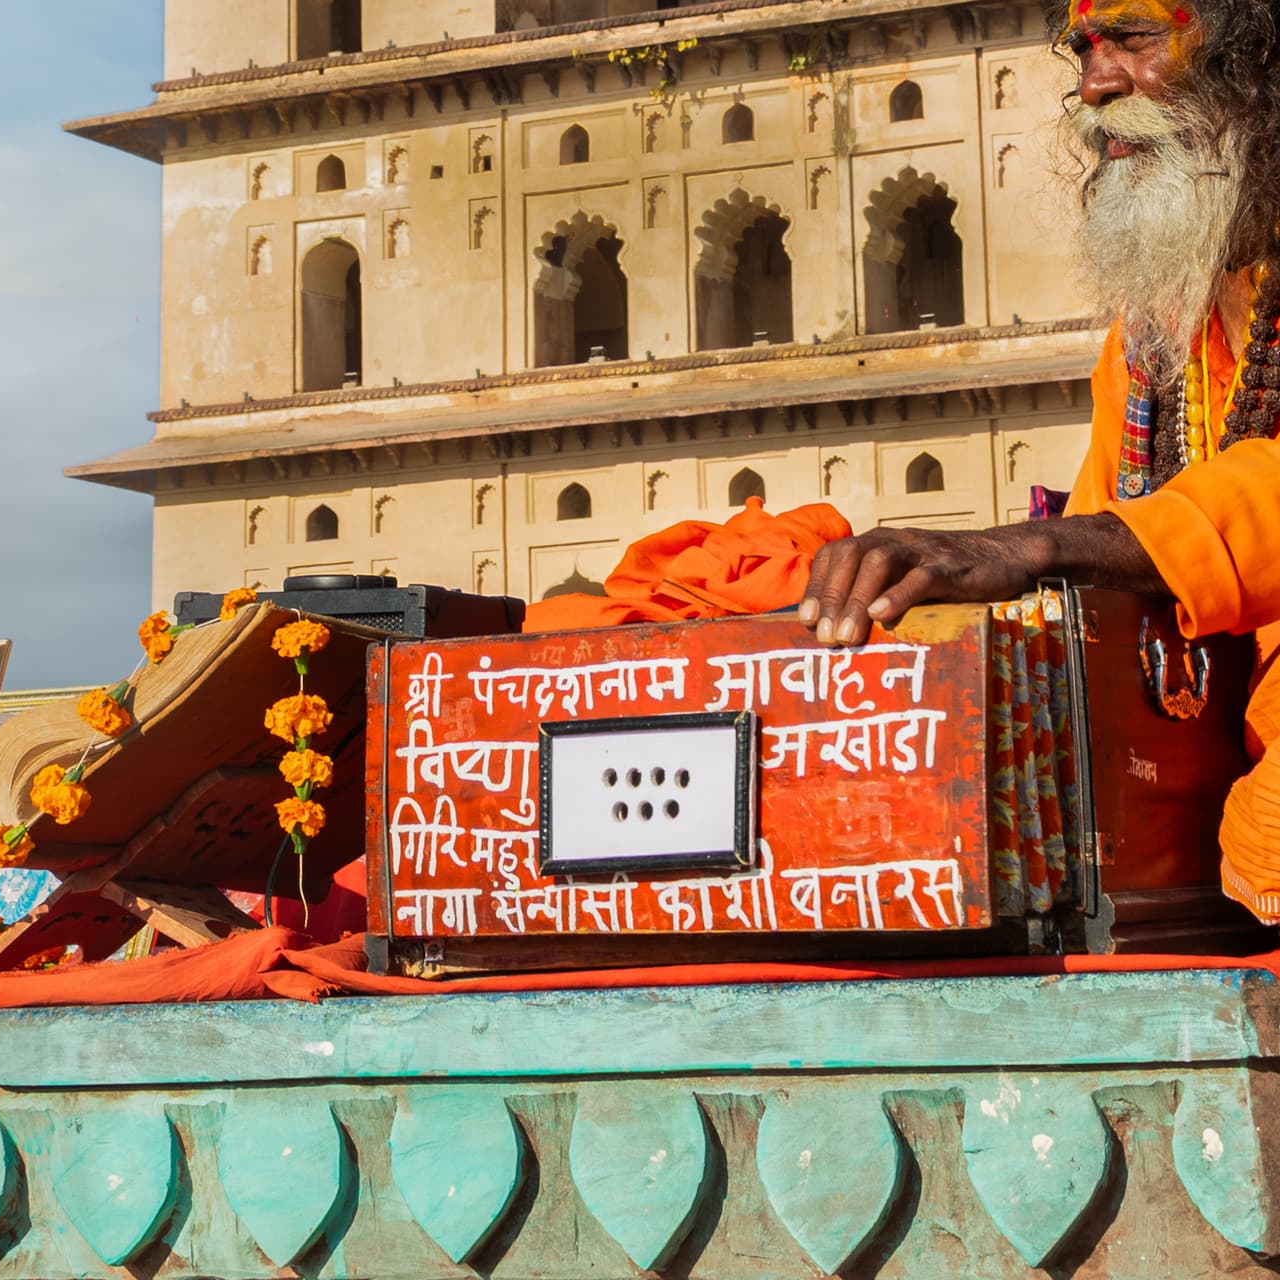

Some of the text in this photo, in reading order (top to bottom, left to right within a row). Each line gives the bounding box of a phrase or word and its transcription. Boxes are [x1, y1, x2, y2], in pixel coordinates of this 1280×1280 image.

[405, 652, 454, 718] श्री
[467, 656, 690, 718] पंचदशनाम
[395, 719, 539, 825] विष्णु
[389, 795, 468, 876] गिरि
[394, 888, 483, 935] नागा
[650, 838, 777, 931] काशी
[780, 858, 965, 932] बनारस
